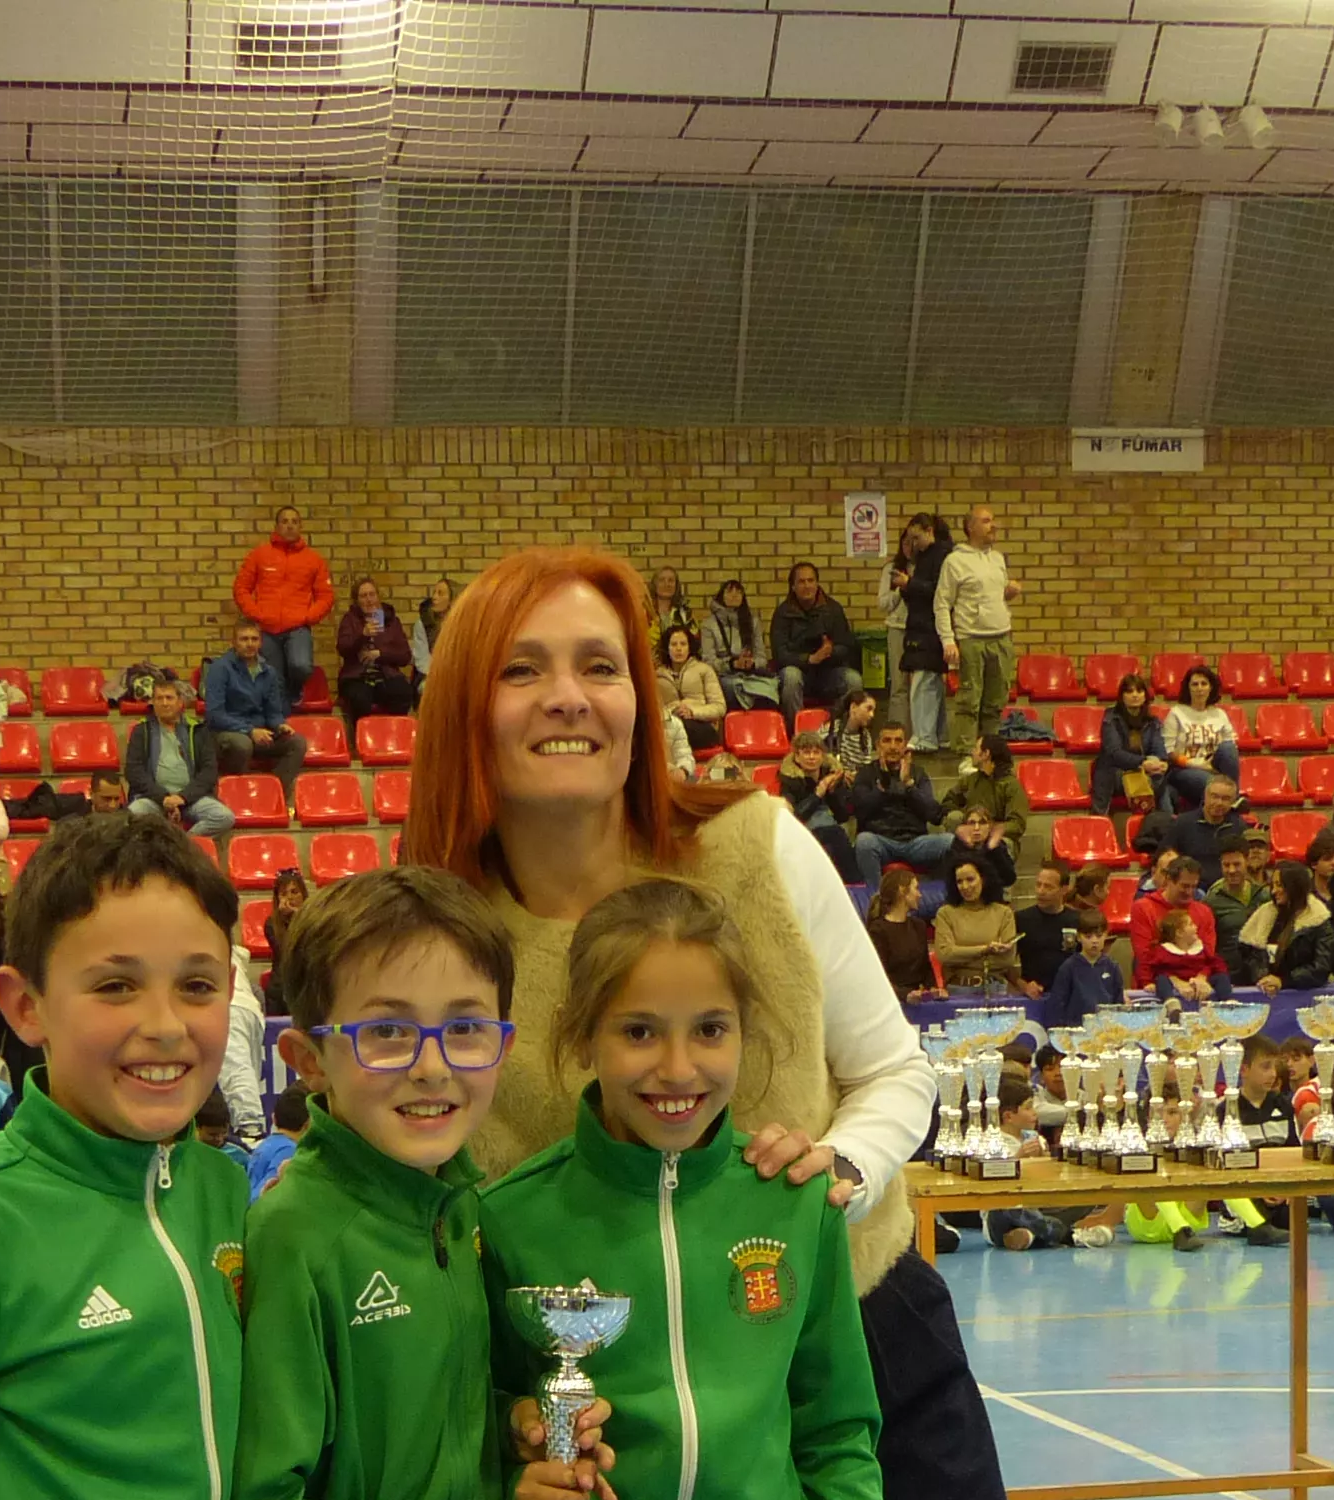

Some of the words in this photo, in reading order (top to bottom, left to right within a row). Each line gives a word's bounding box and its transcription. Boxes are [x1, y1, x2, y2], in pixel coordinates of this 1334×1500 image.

[1122, 439, 1182, 453] FUMAR
[78, 1308, 133, 1329] adidas
[350, 1304, 411, 1327] ACERBIS
